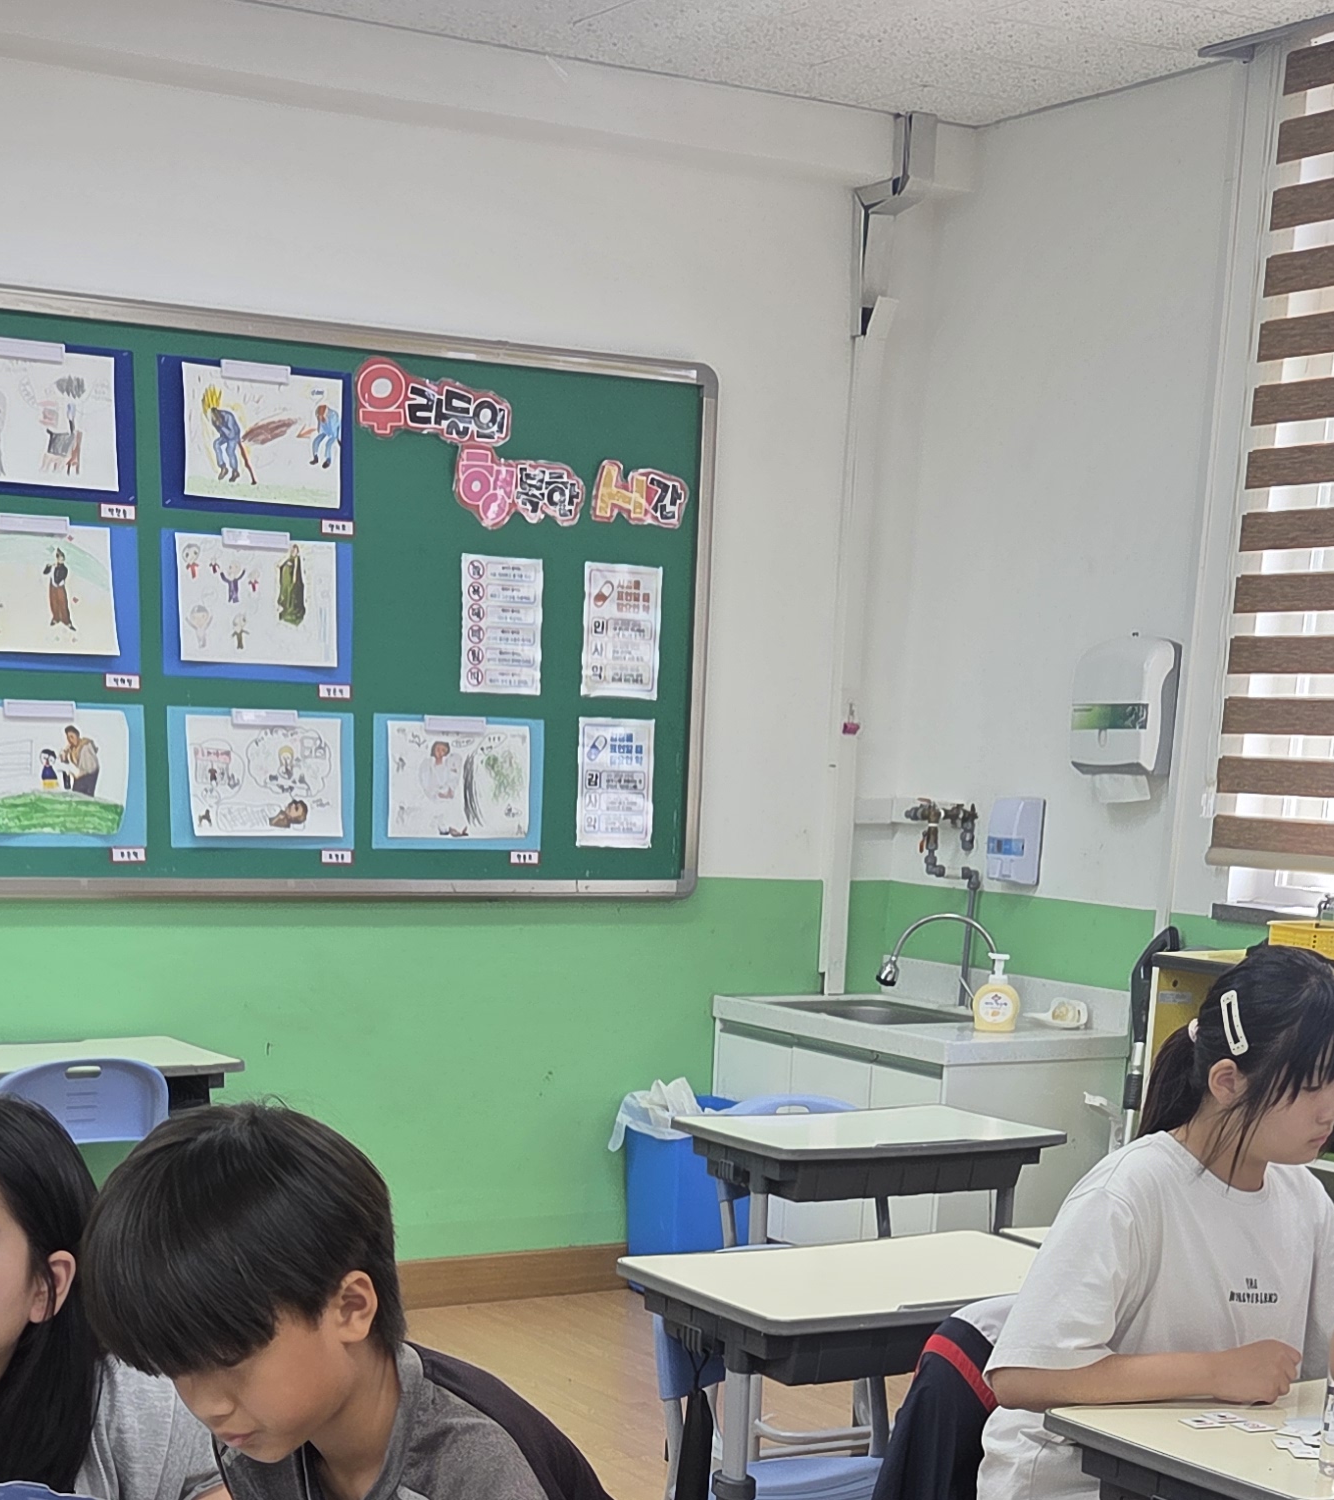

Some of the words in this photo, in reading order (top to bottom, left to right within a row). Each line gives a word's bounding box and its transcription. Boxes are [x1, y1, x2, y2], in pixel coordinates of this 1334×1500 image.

[357, 364, 507, 441] 우리들의
[459, 450, 580, 525] 행복한
[595, 464, 685, 522] 시간
